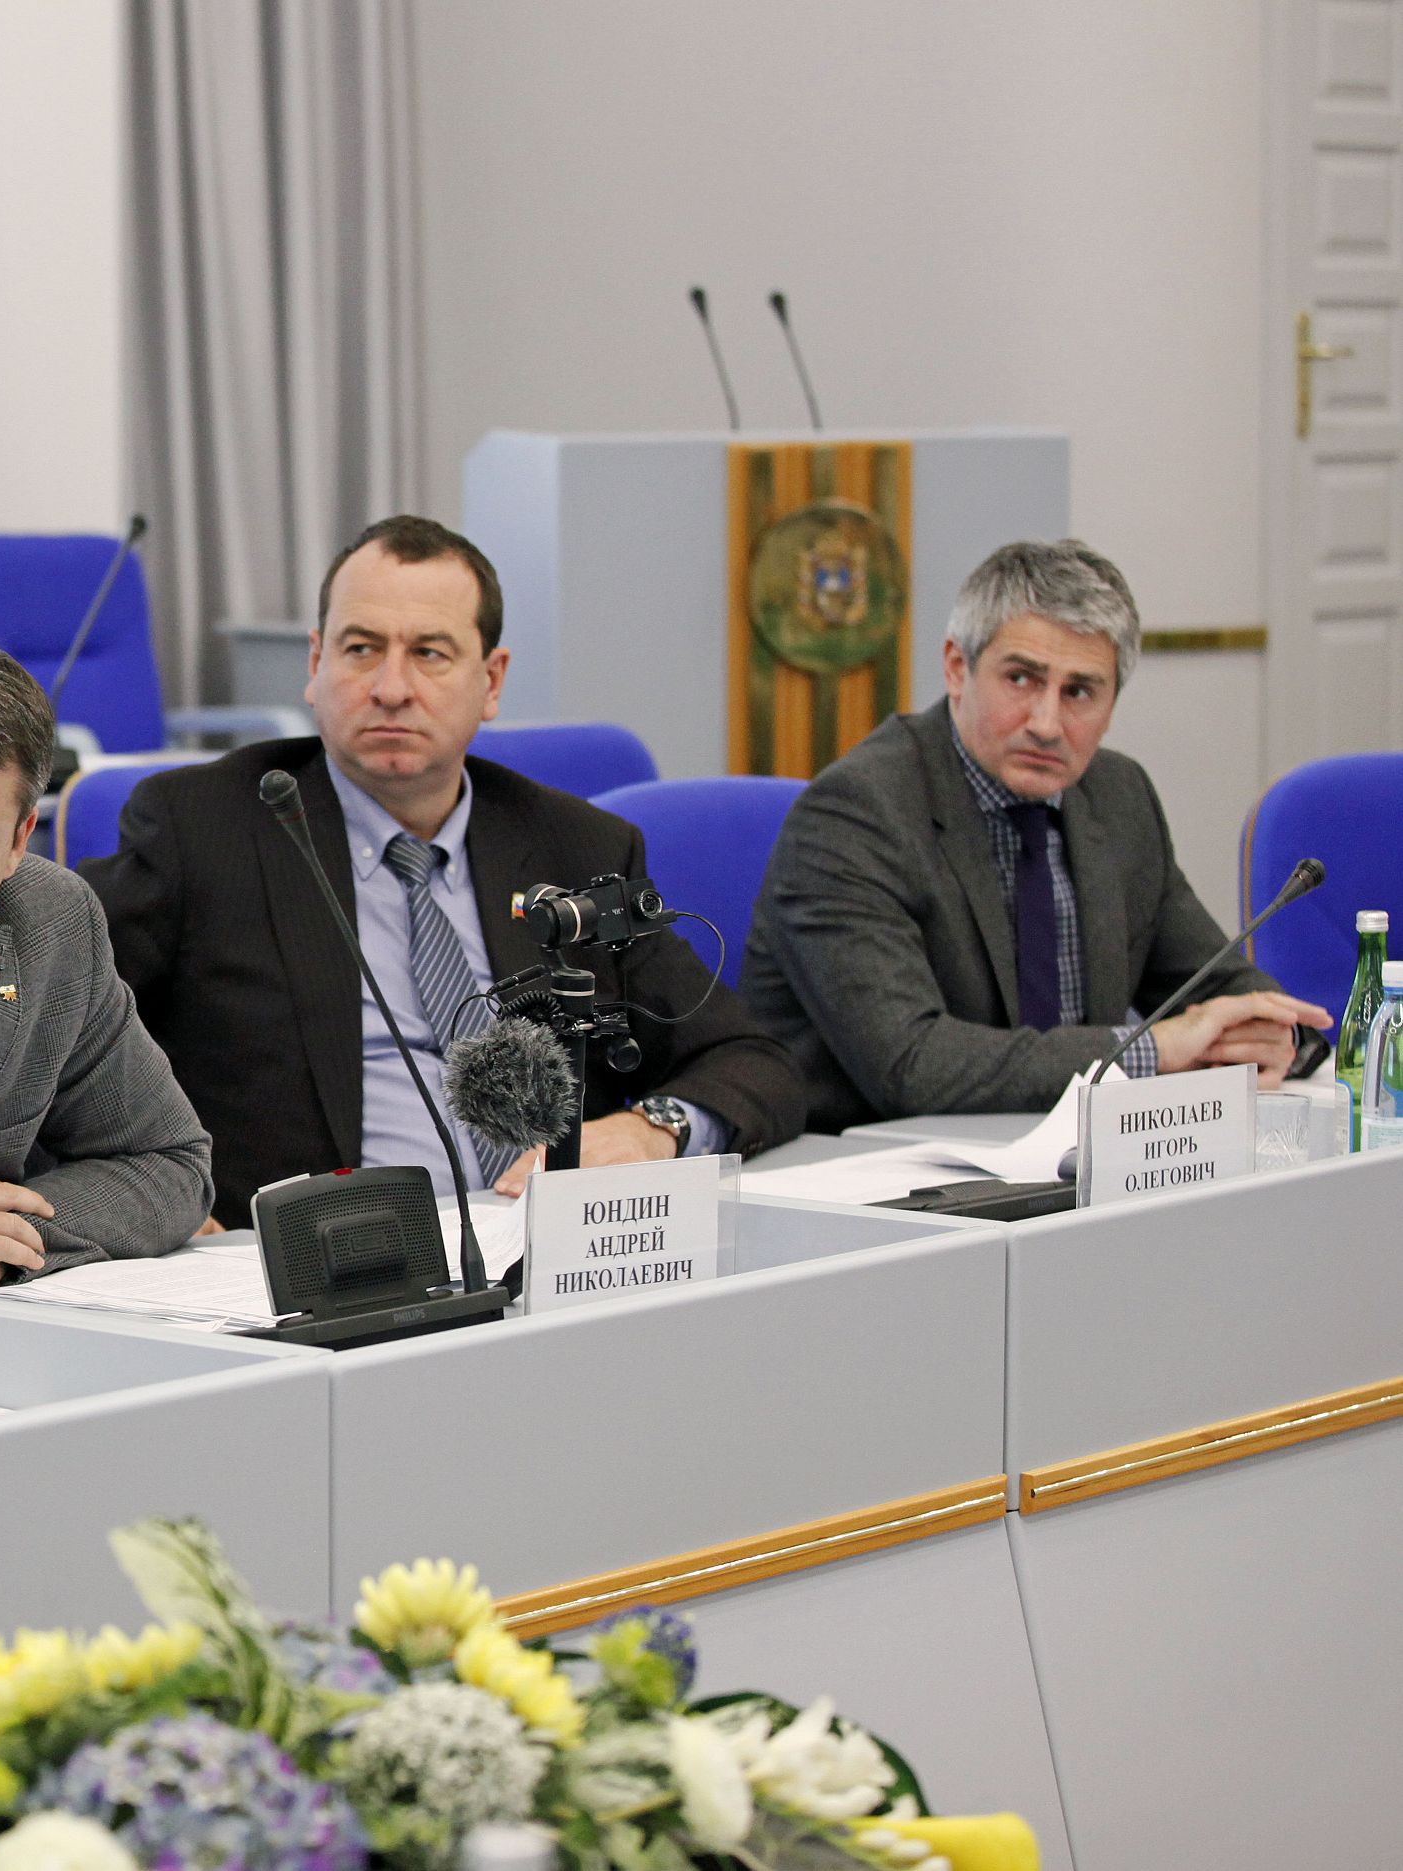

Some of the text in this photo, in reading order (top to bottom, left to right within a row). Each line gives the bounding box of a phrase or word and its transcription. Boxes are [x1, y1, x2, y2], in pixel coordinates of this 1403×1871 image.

[1120, 1100, 1223, 1134] НИКОЛАЕВ
[1145, 1136, 1198, 1160] ИГОРЬ
[1125, 1161, 1215, 1192] ОЛЕГОВИЧ
[582, 1195, 670, 1227] ЮНДИН
[585, 1226, 666, 1259] АНДРЕЙ
[554, 1259, 693, 1294] НИКОЛАЕВИЧ
